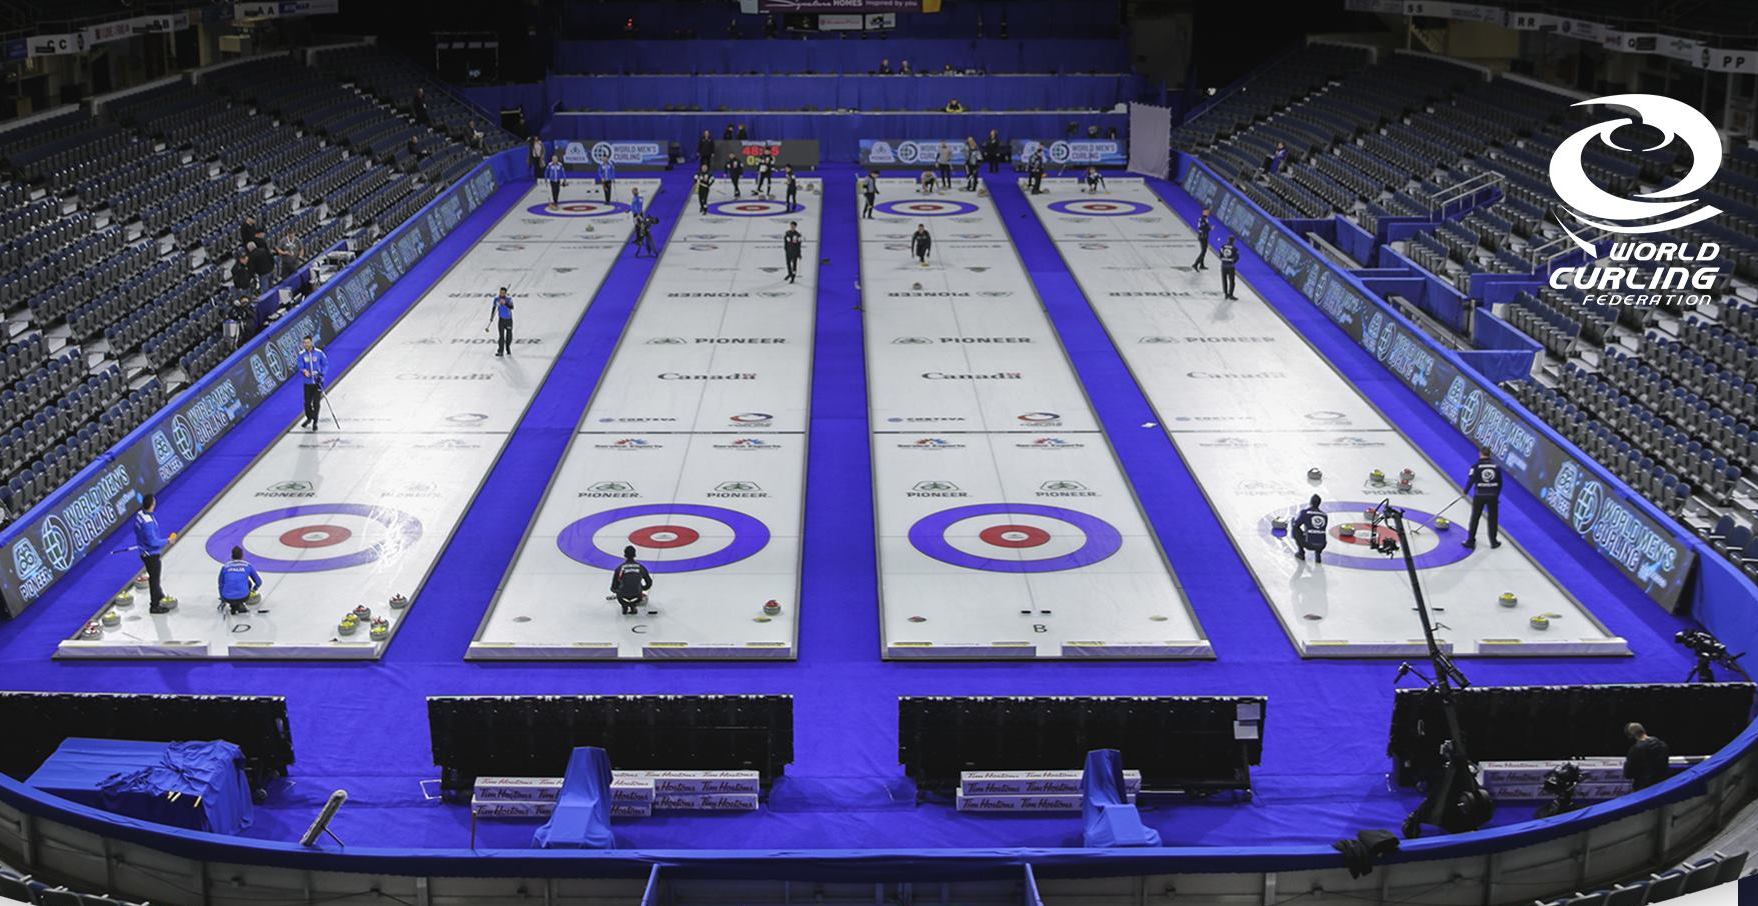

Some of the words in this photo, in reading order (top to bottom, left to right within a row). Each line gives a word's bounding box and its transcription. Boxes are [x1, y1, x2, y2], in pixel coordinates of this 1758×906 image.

[656, 371, 758, 380] Canada
[920, 371, 1023, 380] Canada
[63, 484, 102, 528] WORLD
[99, 464, 130, 504] MEN'S
[72, 502, 117, 551] CURLING
[1601, 497, 1640, 542] WORLD
[1636, 526, 1677, 572] MEN'S
[1593, 520, 1642, 572] CURLING
[18, 565, 53, 601] PIONEER
[231, 624, 251, 633] D
[632, 624, 648, 634] C
[1033, 624, 1048, 633] B
[660, 780, 696, 791] Hortons
[701, 780, 718, 791] Tim
[719, 781, 754, 791] Hortons
[967, 783, 984, 793] Tim
[984, 782, 1021, 793] Hortons
[1025, 782, 1042, 792] Tim
[1042, 782, 1078, 792] Hortons
[480, 788, 497, 798] Tim
[496, 788, 532, 799] Hortons
[537, 788, 554, 799] Tim
[613, 789, 648, 800] Hortons
[700, 795, 717, 807] Tim
[718, 797, 753, 807] Hortons
[962, 798, 979, 809] Tim
[979, 798, 1014, 809] Hortons
[1020, 798, 1036, 808] Tim
[1037, 798, 1073, 808] Hortons
[494, 804, 529, 815] Hortons
[611, 803, 645, 815] Hortons
